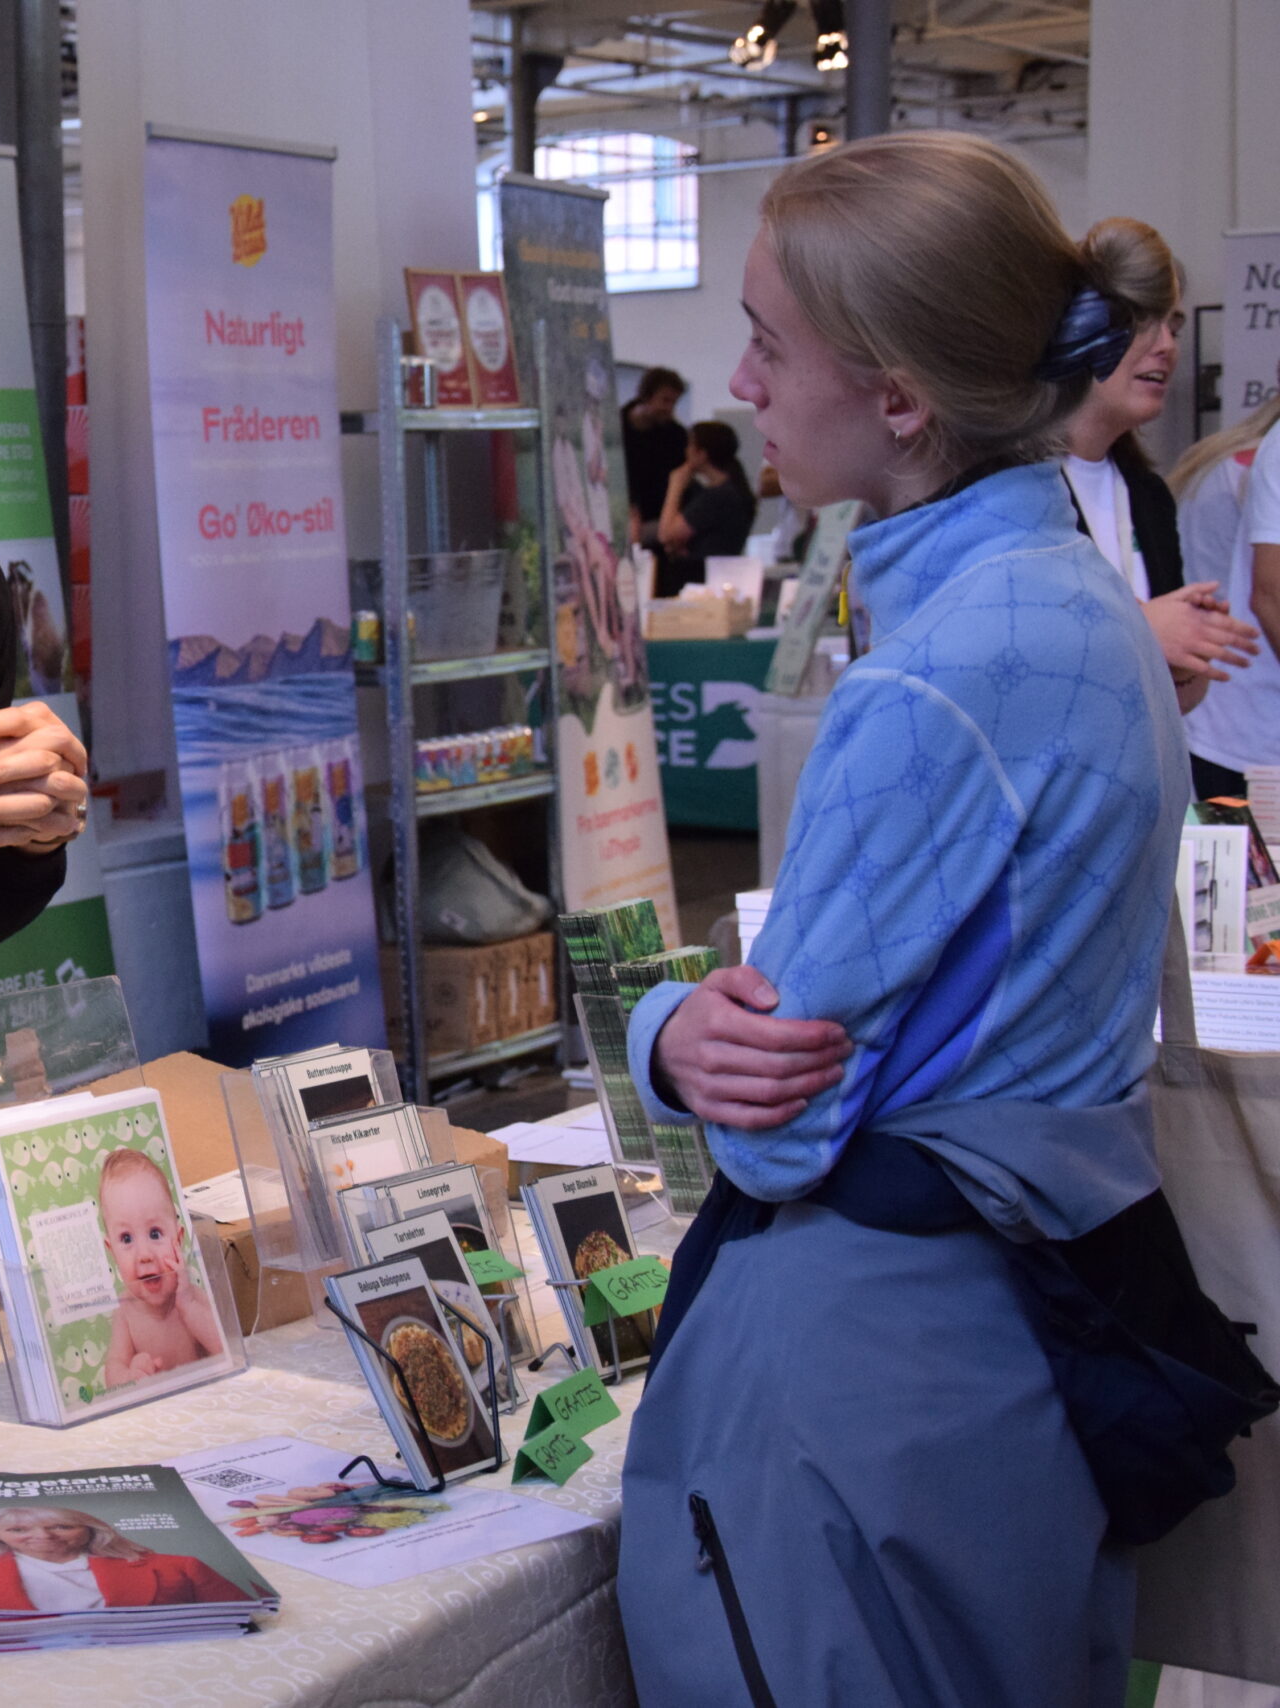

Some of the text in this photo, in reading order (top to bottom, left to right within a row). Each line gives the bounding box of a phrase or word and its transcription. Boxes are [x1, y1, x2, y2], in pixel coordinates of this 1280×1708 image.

[204, 309, 306, 356] Naturligt
[201, 405, 321, 443] Fråderen
[247, 497, 334, 538] Øko-stil
[607, 1268, 669, 1301] GRATIS
[554, 1383, 602, 1421] GRATIS
[533, 1433, 577, 1471] GRATIS
